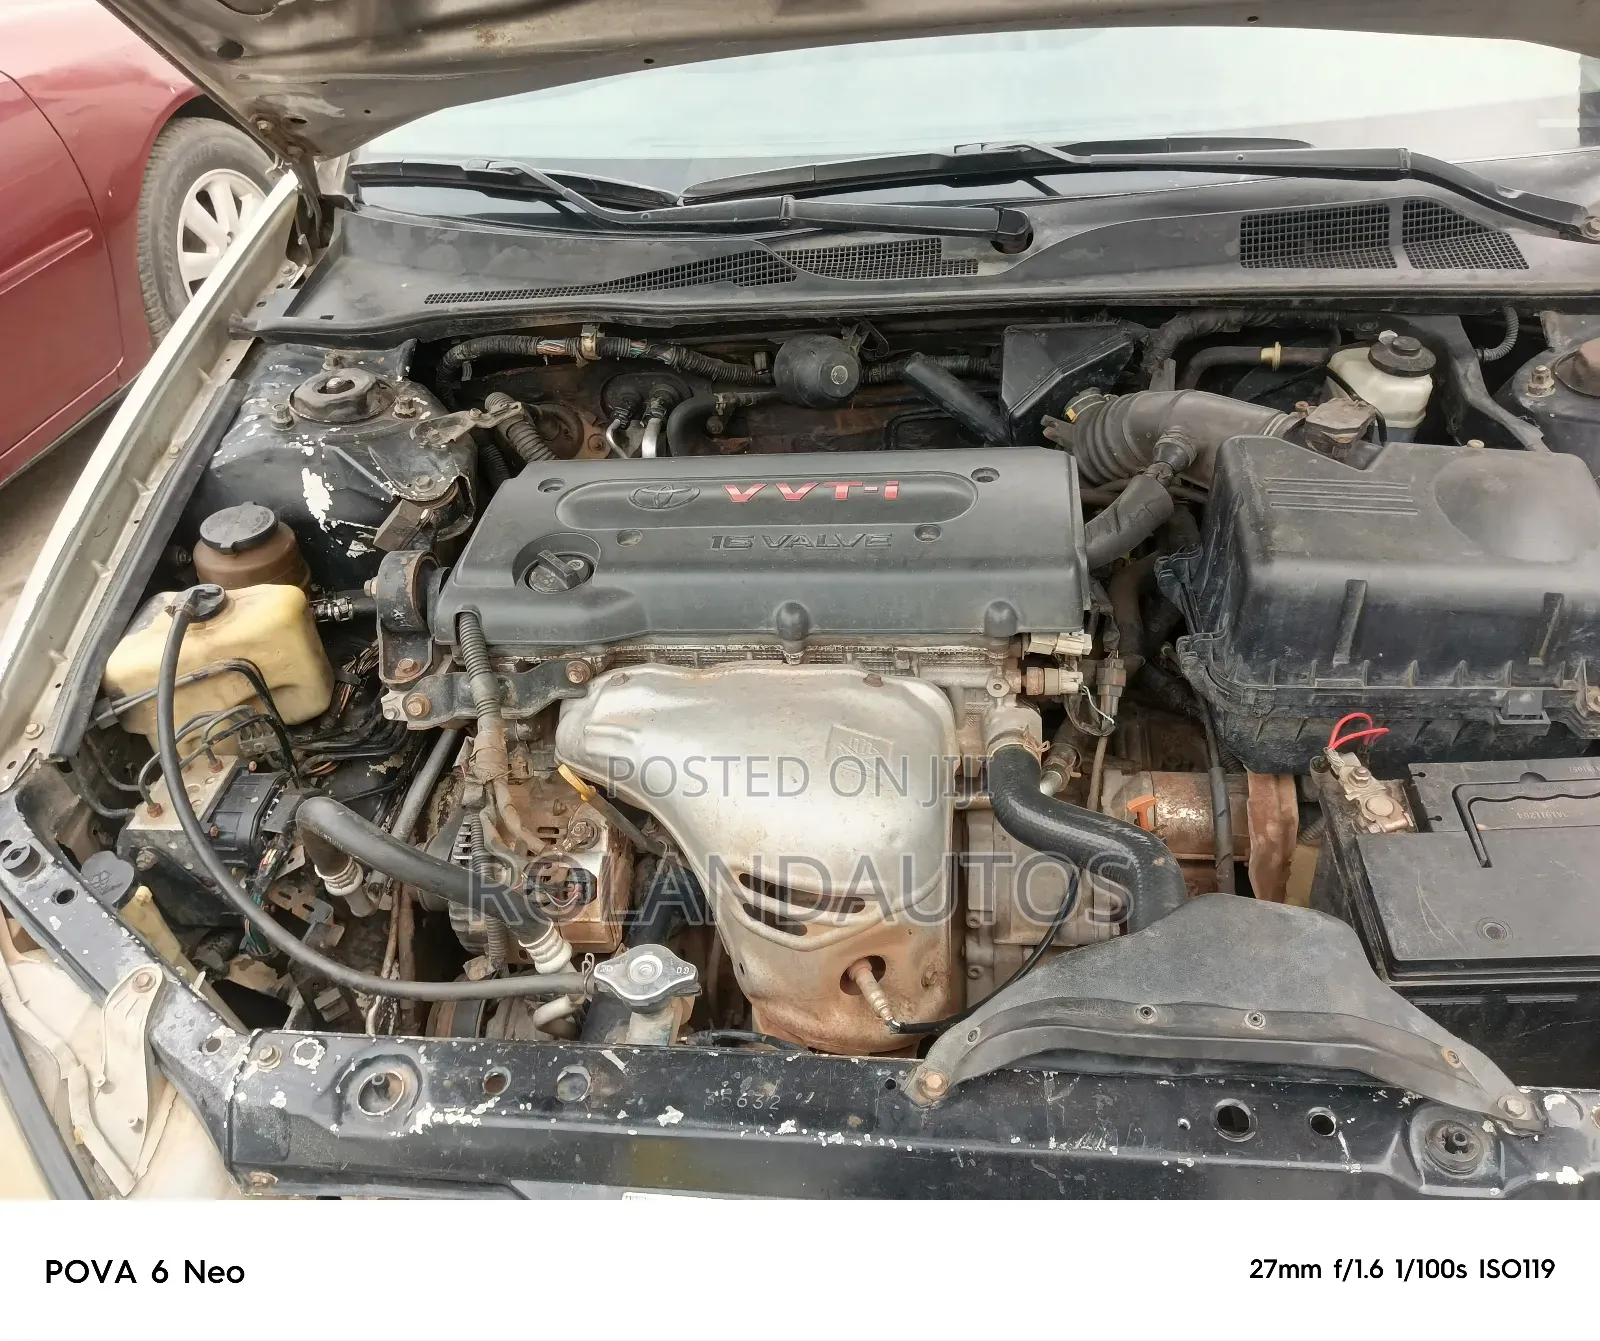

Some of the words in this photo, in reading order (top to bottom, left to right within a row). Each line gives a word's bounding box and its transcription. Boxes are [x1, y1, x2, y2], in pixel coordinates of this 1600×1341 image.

[723, 480, 899, 502] VVT-i
[709, 534, 755, 550] 16
[761, 533, 893, 550] VALVE
